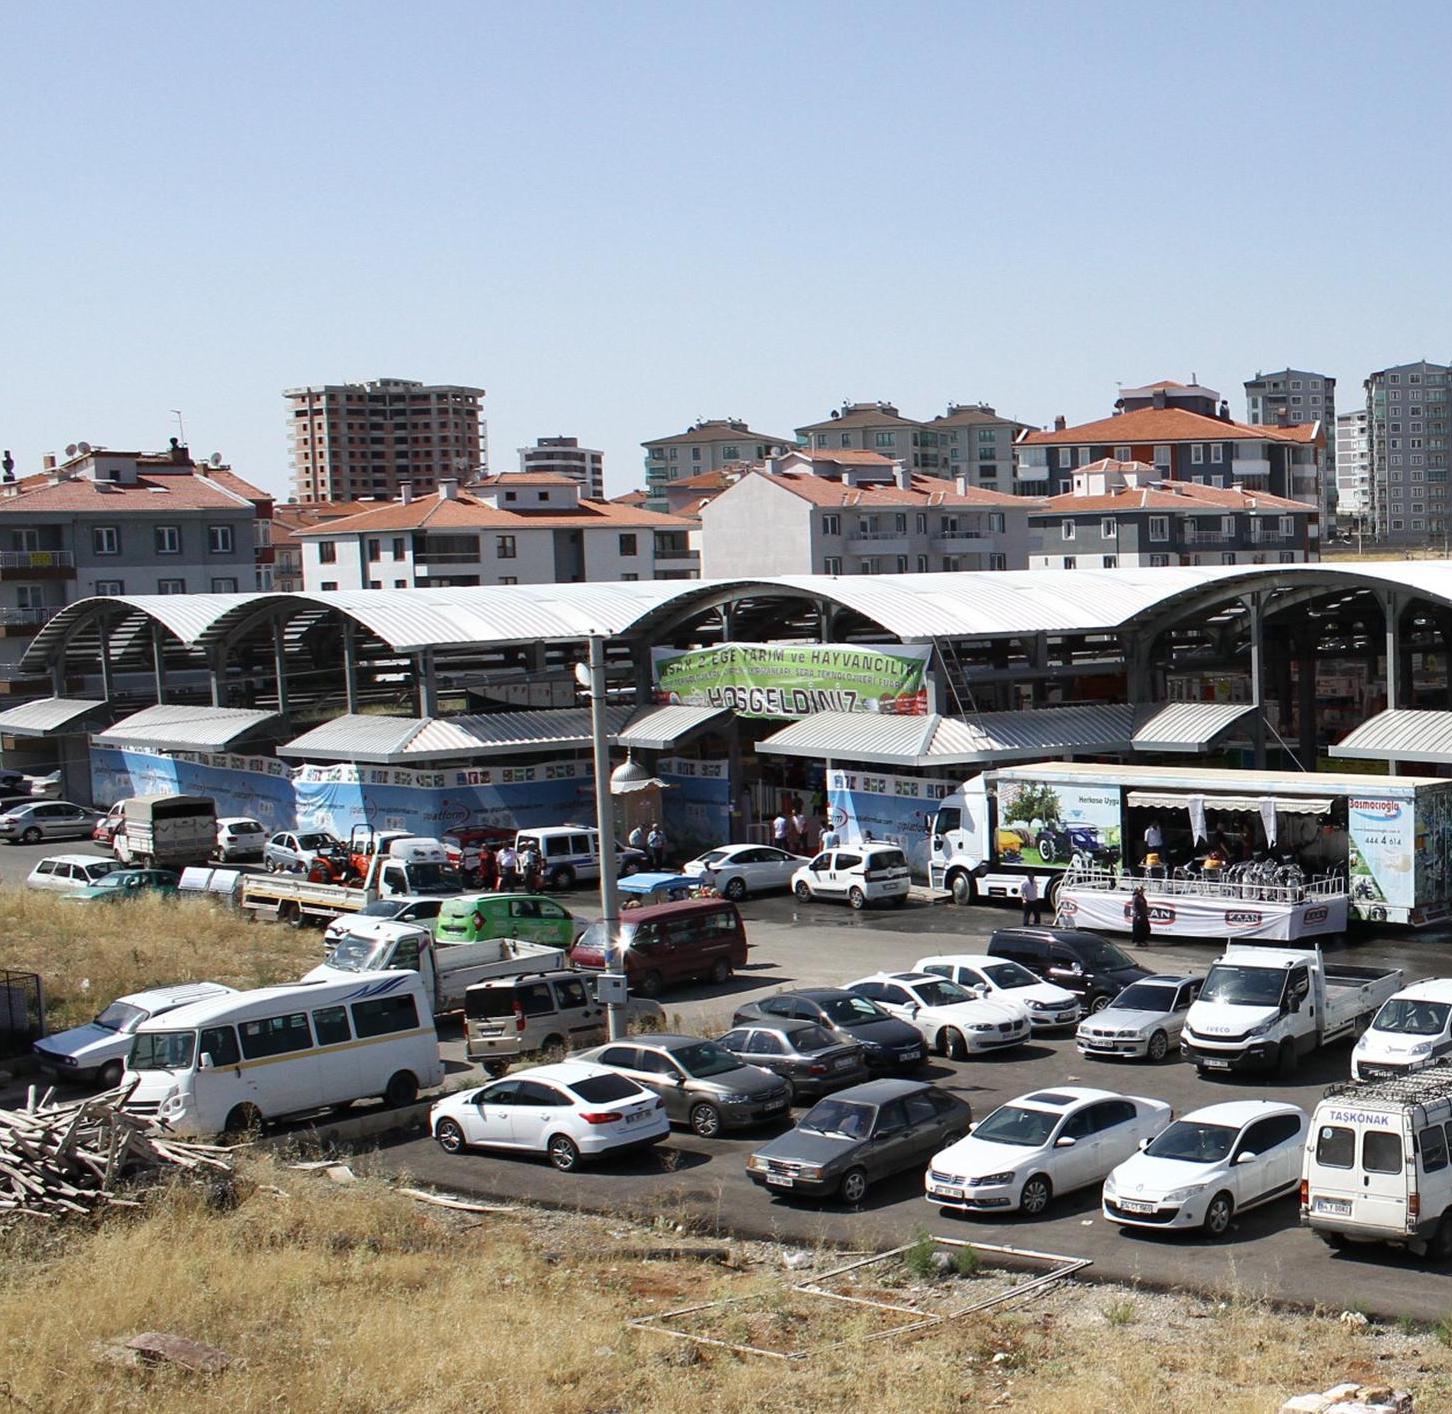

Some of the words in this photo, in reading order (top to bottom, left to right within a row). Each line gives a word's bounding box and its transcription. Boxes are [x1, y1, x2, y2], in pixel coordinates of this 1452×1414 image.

[712, 650, 736, 665] EGE
[743, 649, 784, 662] TARIM
[791, 652, 805, 663] ve
[812, 652, 914, 676] HAYVANCILK
[1365, 836, 1378, 844] 444
[1129, 907, 1171, 921] KAN
[1330, 1111, 1389, 1125] TAŞKONAK
